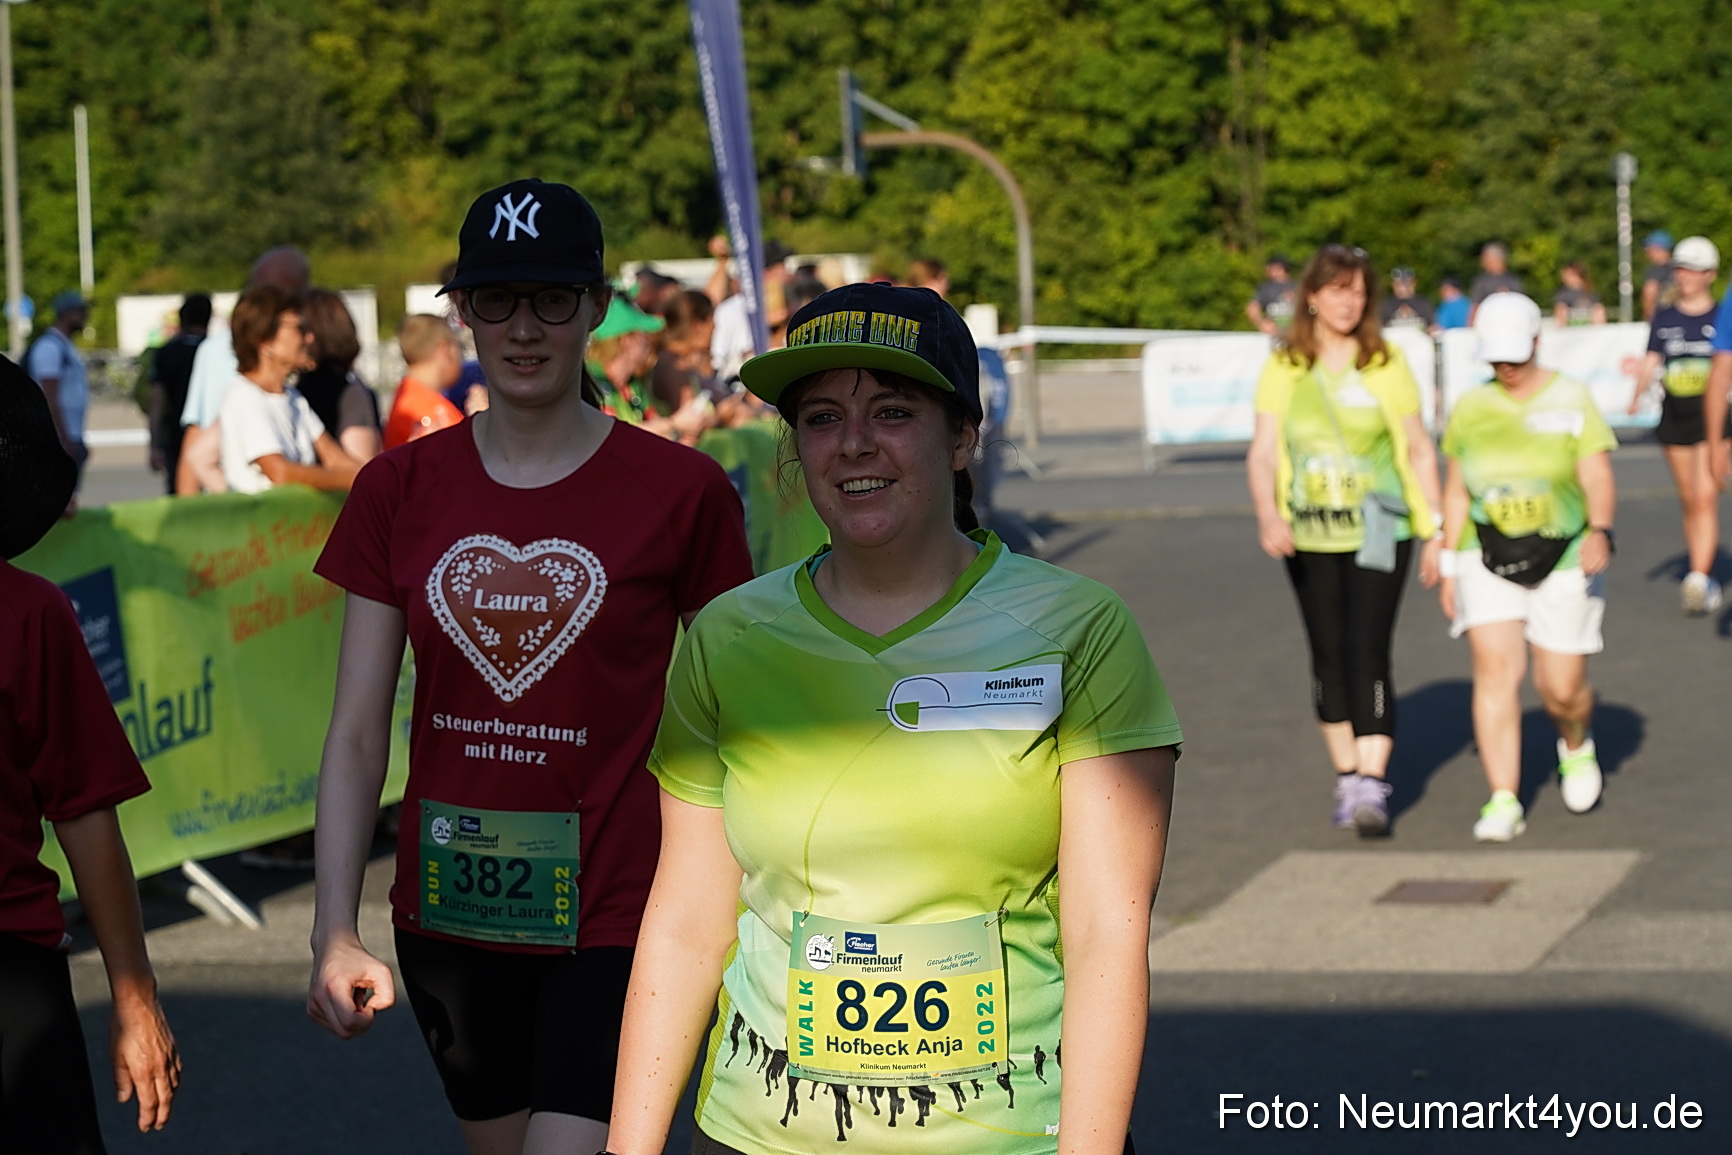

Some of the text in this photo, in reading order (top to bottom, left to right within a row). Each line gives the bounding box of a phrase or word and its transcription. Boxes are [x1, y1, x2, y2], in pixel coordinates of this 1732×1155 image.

[489, 192, 541, 241] NY
[869, 312, 921, 351] ONE
[473, 588, 549, 613] Laura
[983, 689, 1044, 700] Neumarkt
[985, 676, 1044, 691] Klinikum
[122, 658, 213, 760] nlauf
[432, 713, 588, 747] Steuerberatung
[464, 742, 548, 766] mit Herz
[453, 832, 500, 844] Firmenlauf
[428, 861, 440, 905] RUN
[453, 852, 533, 901] 382
[439, 893, 554, 919] Kürzinger Laura
[554, 866, 570, 926] 2022
[836, 953, 903, 966] Firmenlauf
[861, 965, 902, 973] neumarkt
[926, 955, 953, 967] Gesunde
[798, 978, 814, 1057] WALK
[836, 979, 950, 1032] 826
[975, 981, 996, 1055] 2022
[826, 1035, 963, 1057] Hofbeck Anja
[860, 1062, 927, 1071] Klinikum Neumarkt
